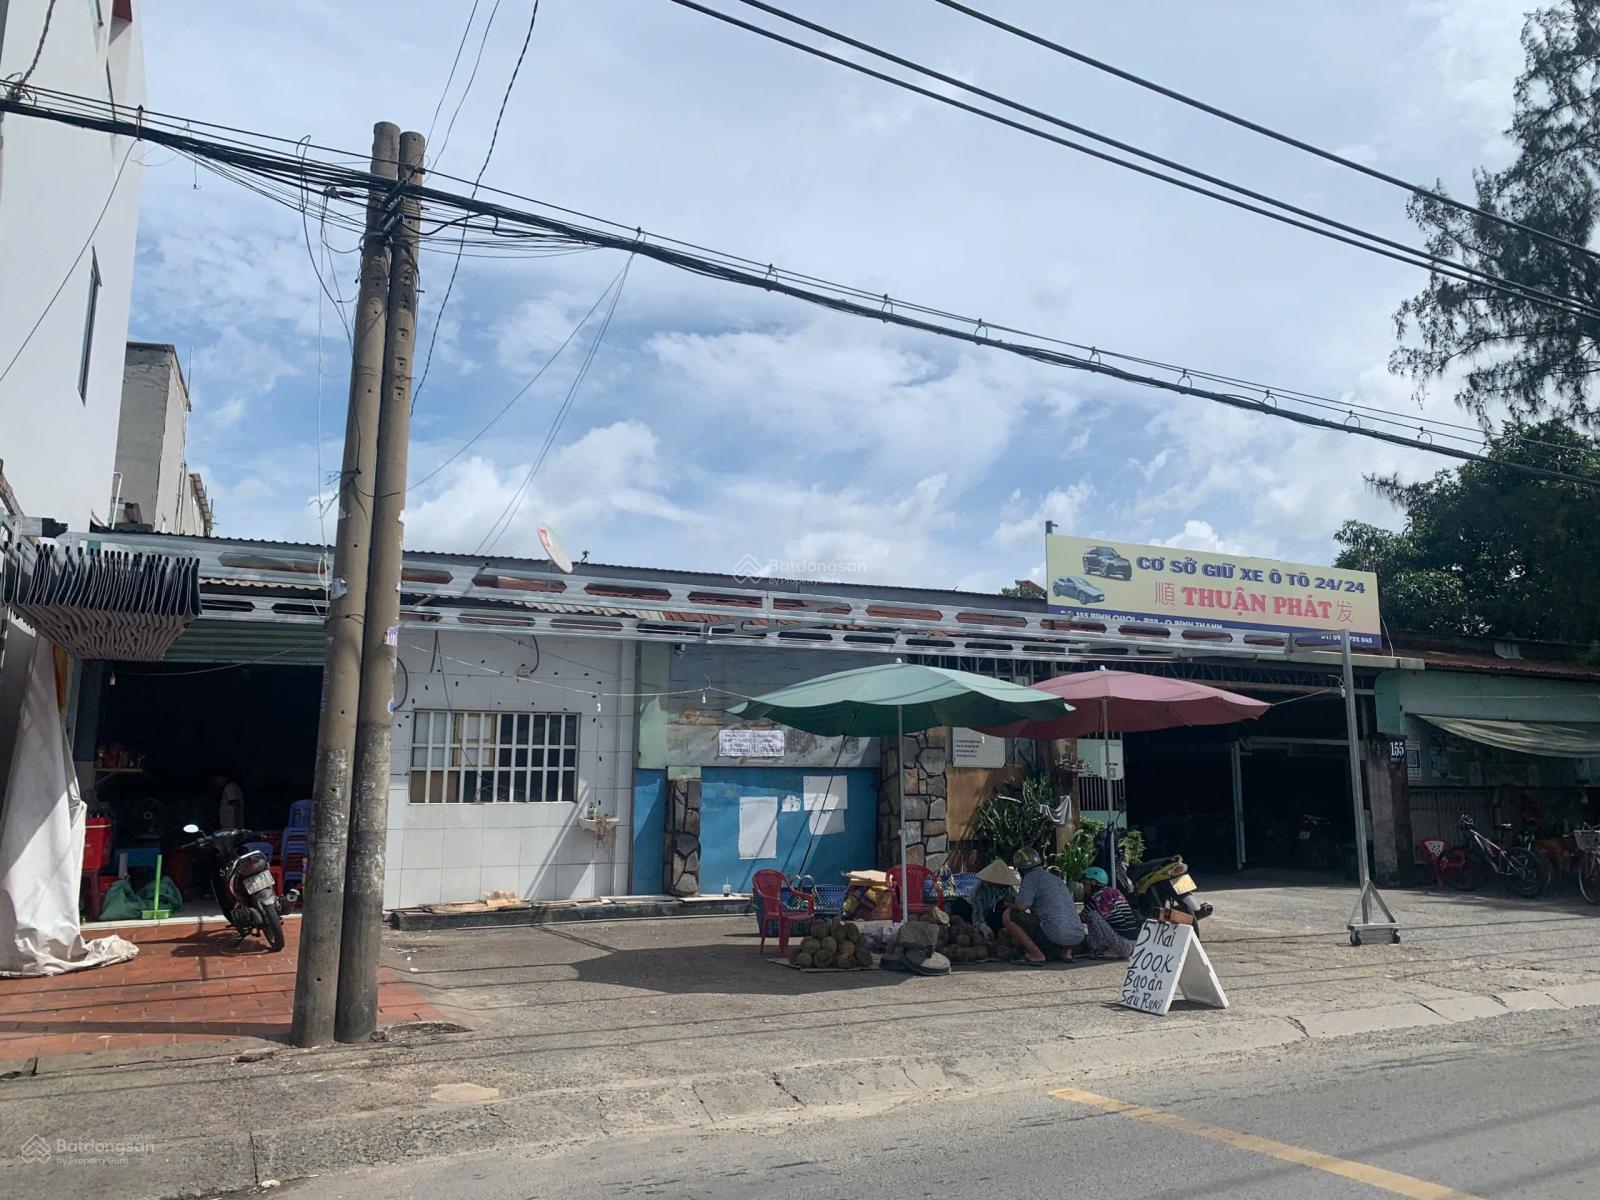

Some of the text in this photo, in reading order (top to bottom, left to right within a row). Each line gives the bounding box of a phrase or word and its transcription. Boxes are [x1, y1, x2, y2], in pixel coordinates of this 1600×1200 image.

[1136, 556, 1366, 594] CƠ SỞ GIỮ XE Ô TÔ 24/24
[1182, 586, 1333, 619] THUẬN PHÁT
[1390, 741, 1405, 756] 155
